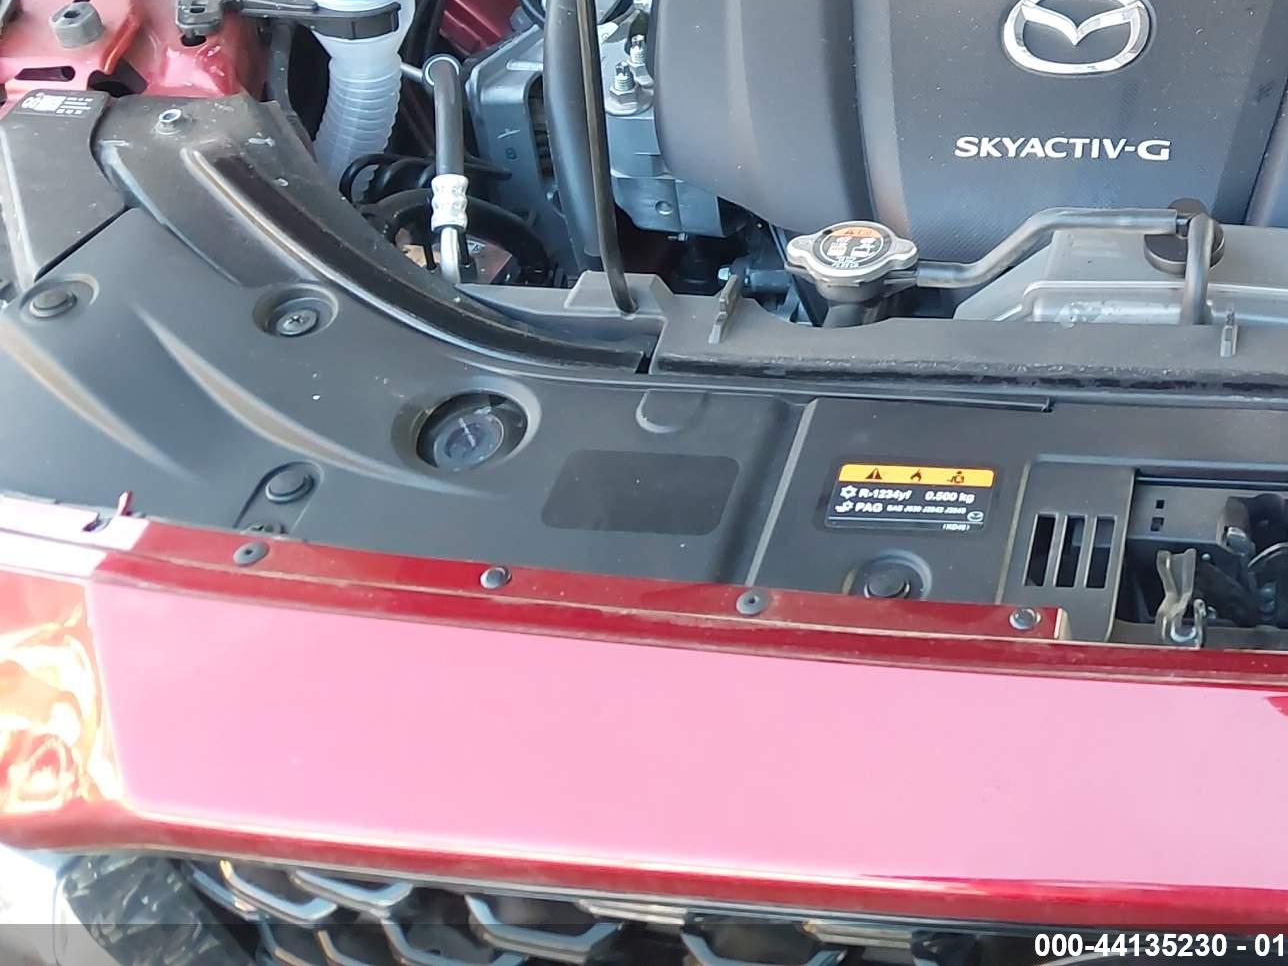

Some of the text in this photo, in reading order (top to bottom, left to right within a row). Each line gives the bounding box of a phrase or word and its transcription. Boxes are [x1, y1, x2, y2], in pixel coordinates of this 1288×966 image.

[954, 135, 1172, 162] SKYACTIV-G
[858, 488, 976, 505] R-1234yf 0.500 kg
[854, 501, 884, 513] PAG
